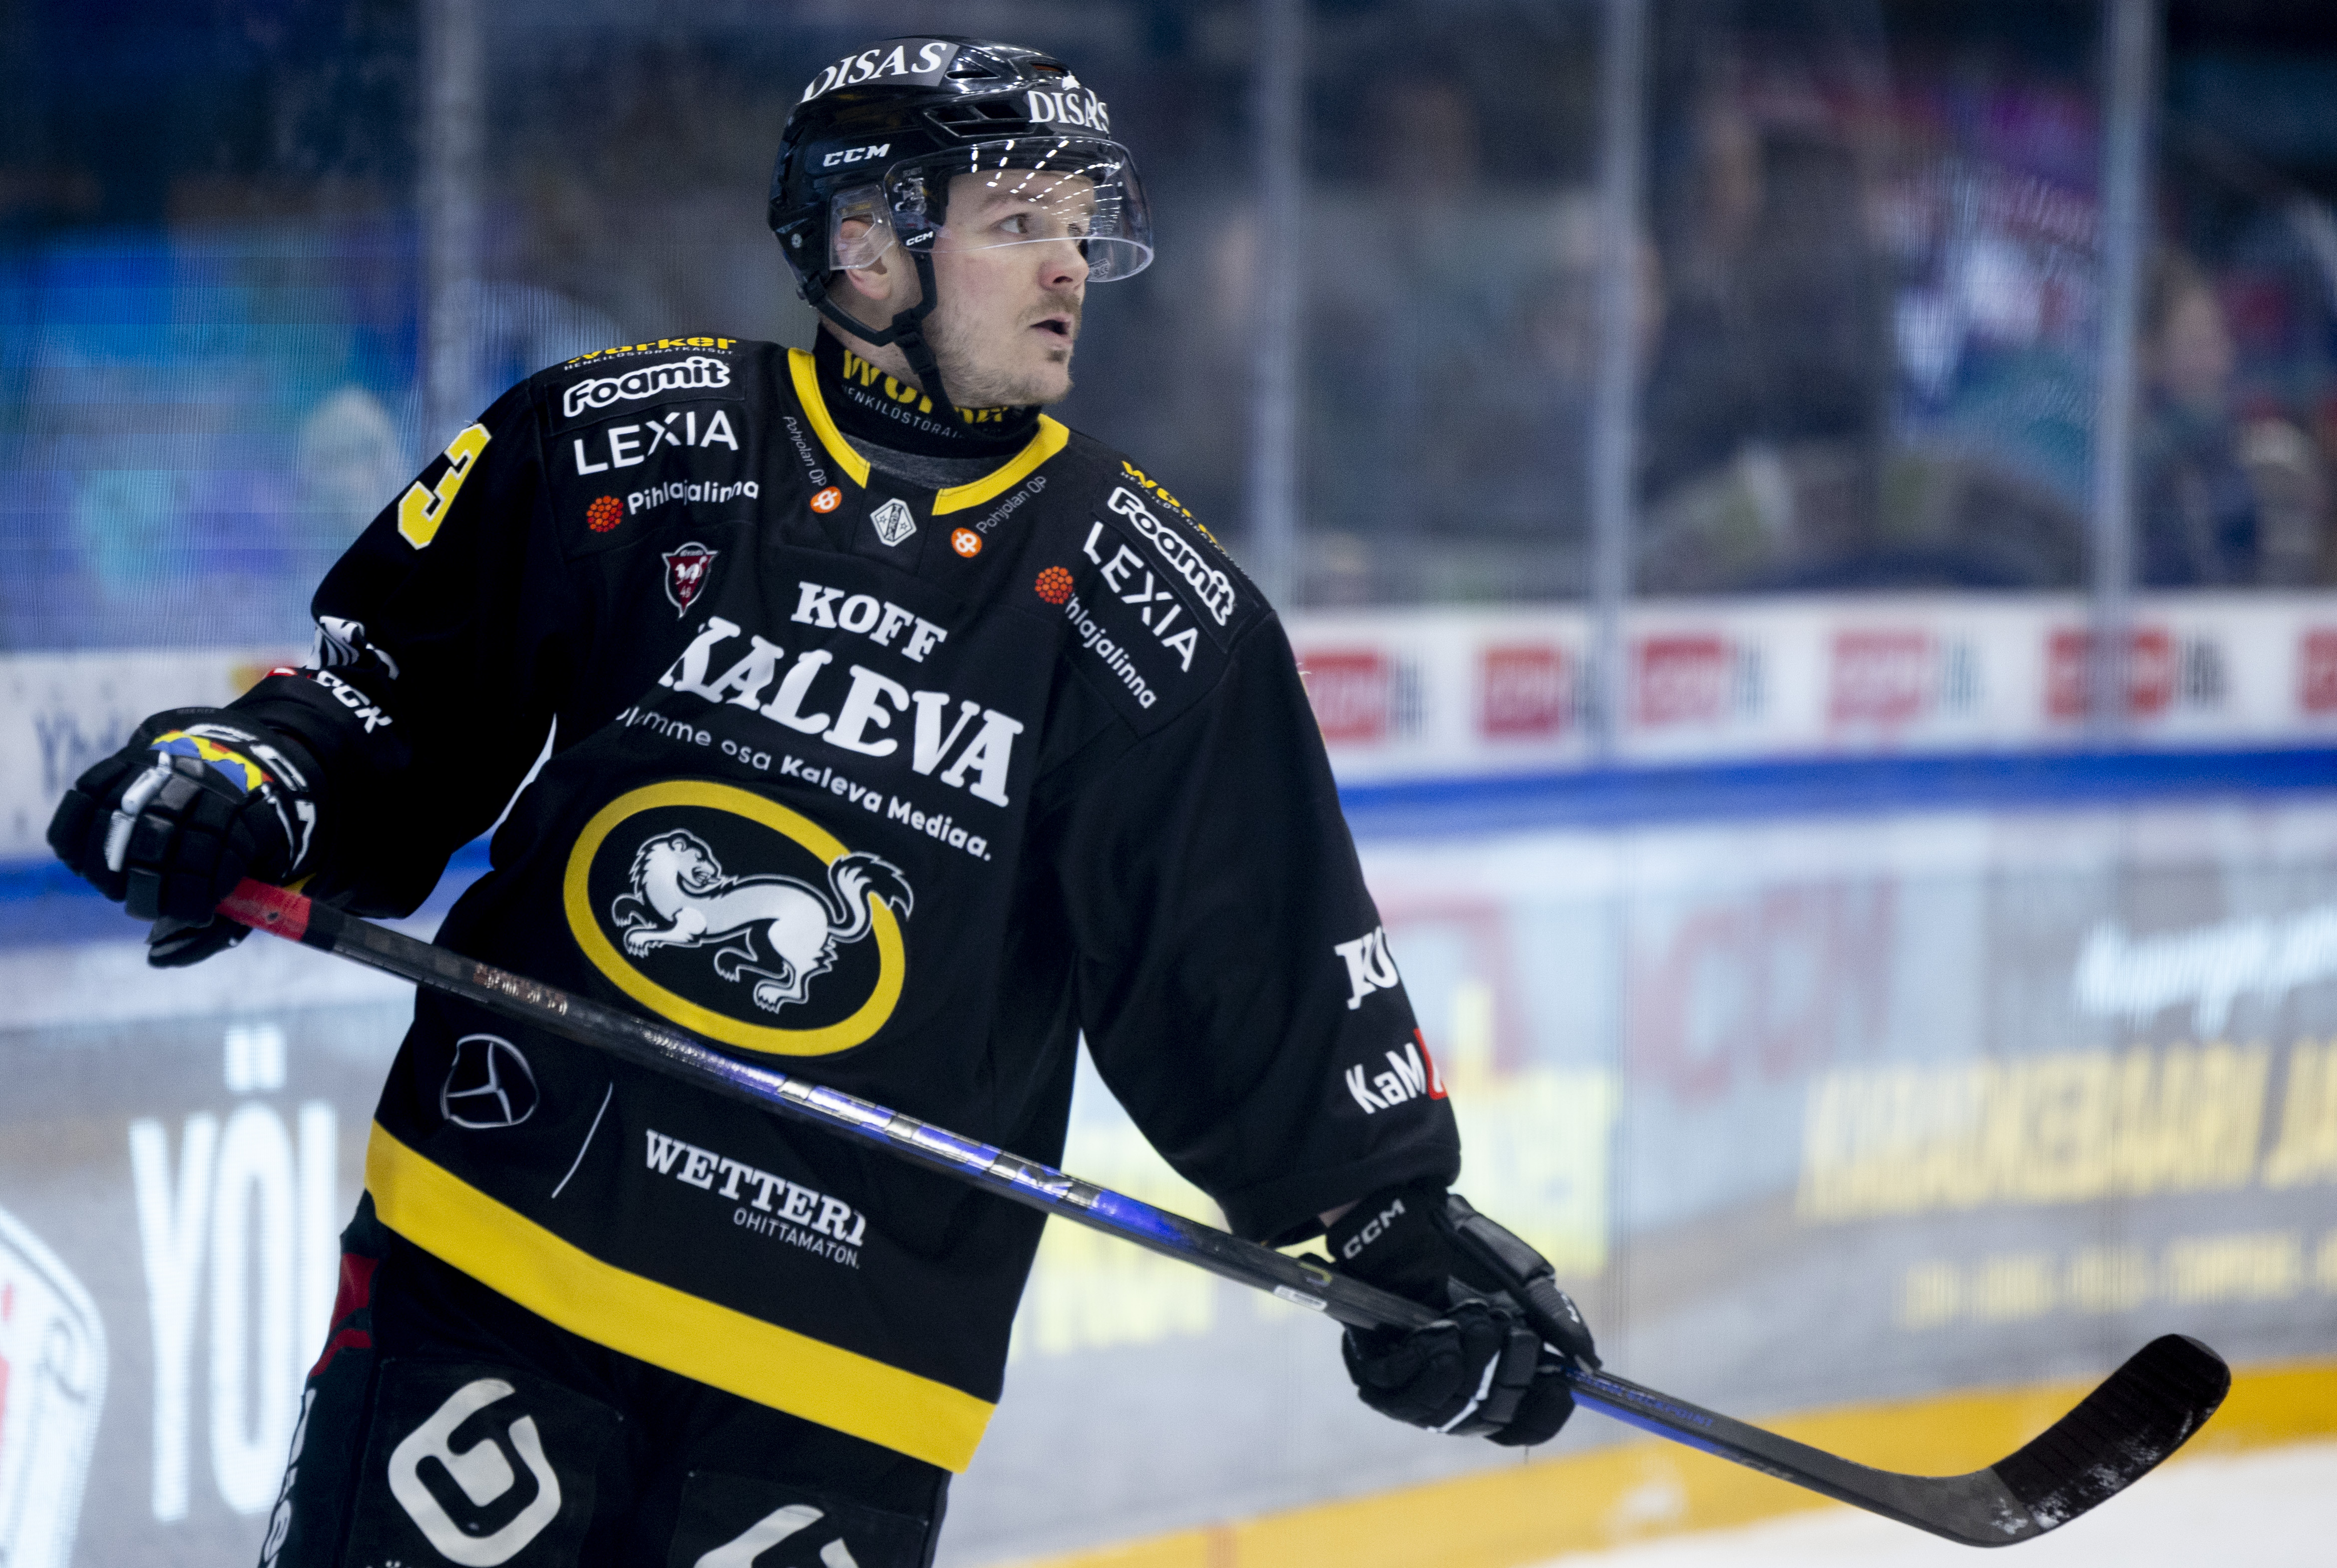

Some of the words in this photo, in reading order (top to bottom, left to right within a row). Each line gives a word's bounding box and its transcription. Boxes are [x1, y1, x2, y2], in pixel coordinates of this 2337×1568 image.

[795, 42, 947, 104] DISAS
[1027, 87, 1110, 134] DISAS
[822, 143, 891, 167] CCM
[906, 231, 934, 247] CCM
[563, 356, 731, 418] Foamit
[574, 410, 739, 476] LEXIA
[627, 480, 759, 515] Pihlajalinna
[808, 468, 827, 487] OP
[975, 490, 1031, 534] Pohjolan
[1026, 476, 1047, 493] OP
[1107, 486, 1234, 627] Foamit
[790, 580, 948, 663] KOFF
[1083, 521, 1199, 673] LEXIA
[1065, 592, 1158, 709] hlajalinna
[721, 739, 772, 771] osa
[780, 754, 883, 814] Kaleva
[887, 796, 992, 861] Mediaa.
[733, 1206, 861, 1270] OHITTAMATON.
[1343, 1199, 1406, 1259] CCM
